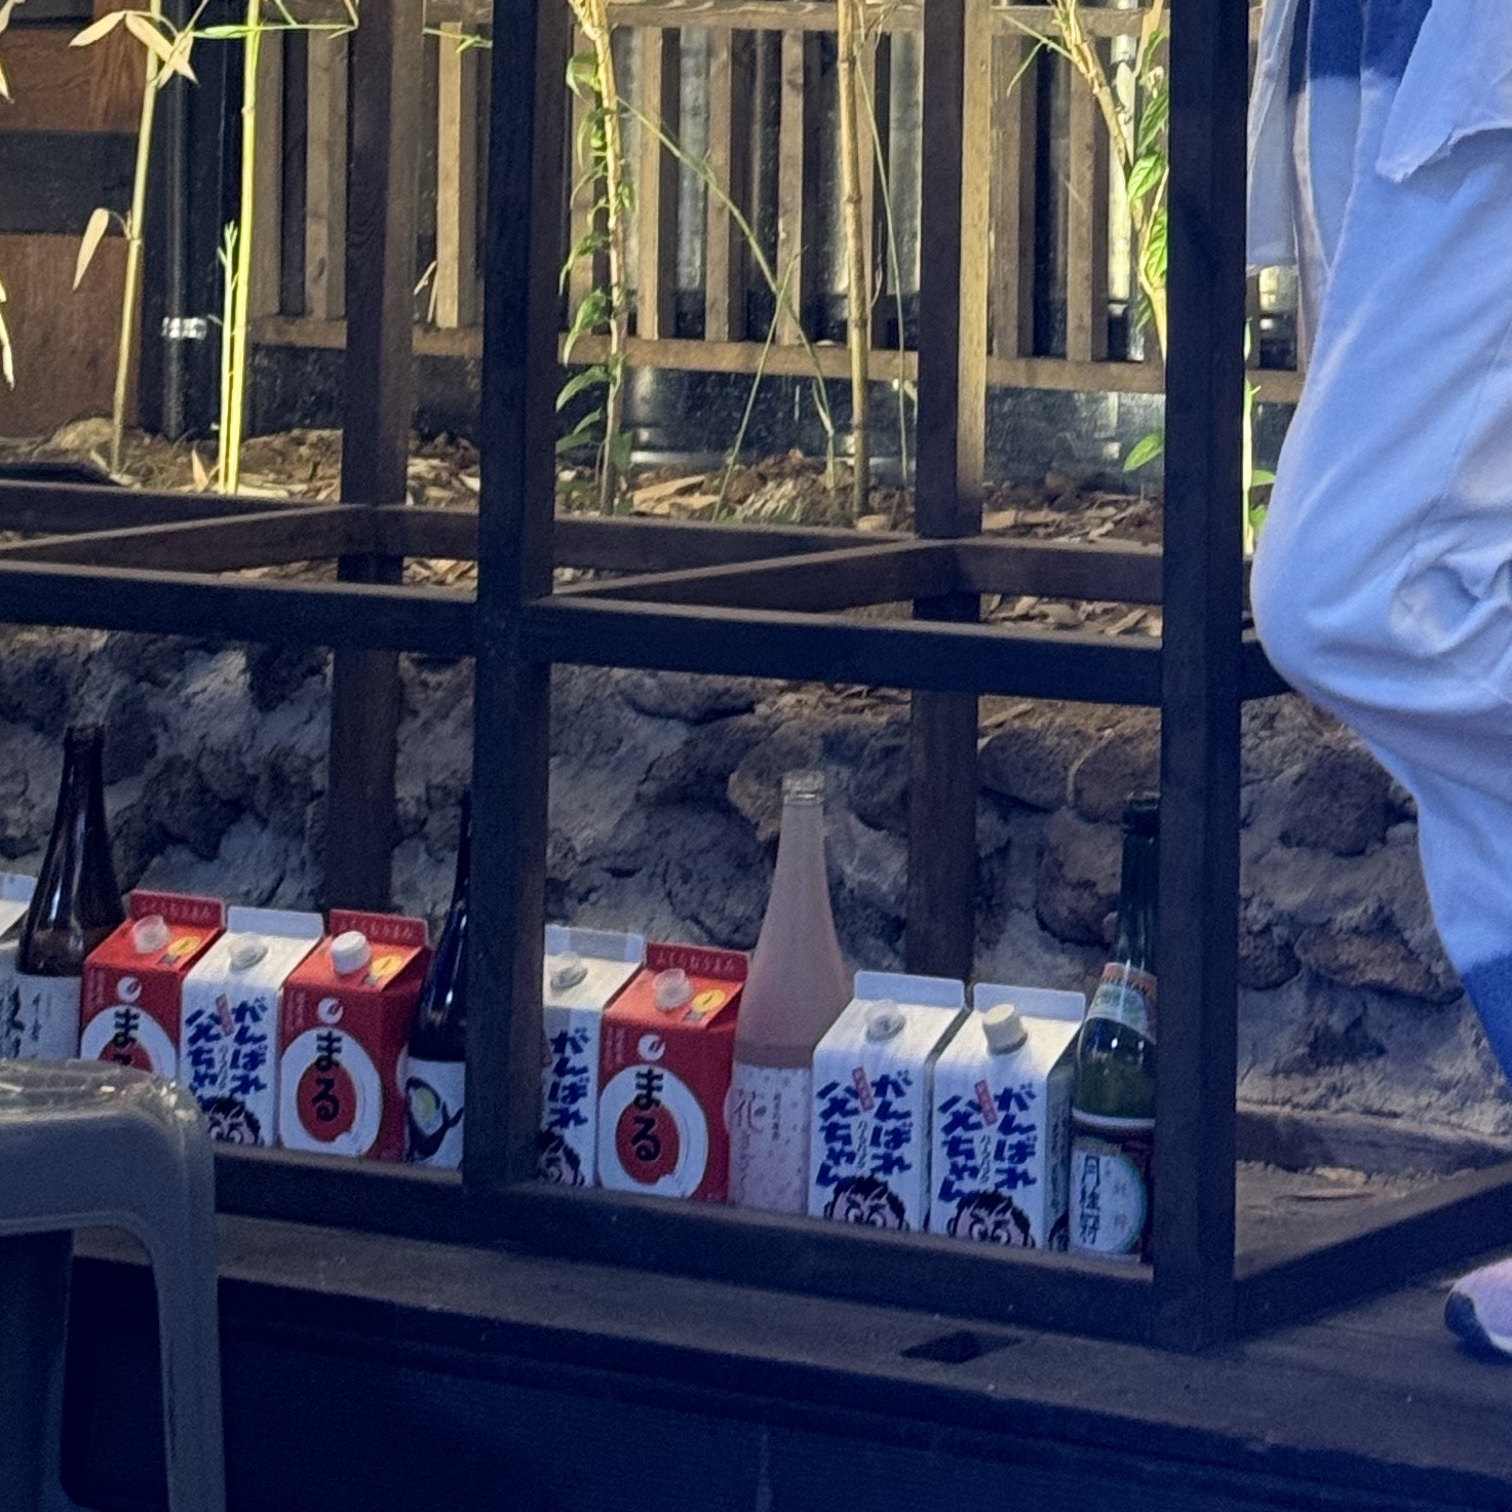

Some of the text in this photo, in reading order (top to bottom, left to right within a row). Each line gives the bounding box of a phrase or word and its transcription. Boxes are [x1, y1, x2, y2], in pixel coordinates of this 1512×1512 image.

[185, 1009, 222, 1096] 父ちゃ
[229, 996, 268, 1096] がんばれ
[313, 1030, 343, 1122] まる
[632, 1068, 665, 1162] まる
[869, 1070, 913, 1177] がんばれ
[994, 1082, 1038, 1190] がんばれ
